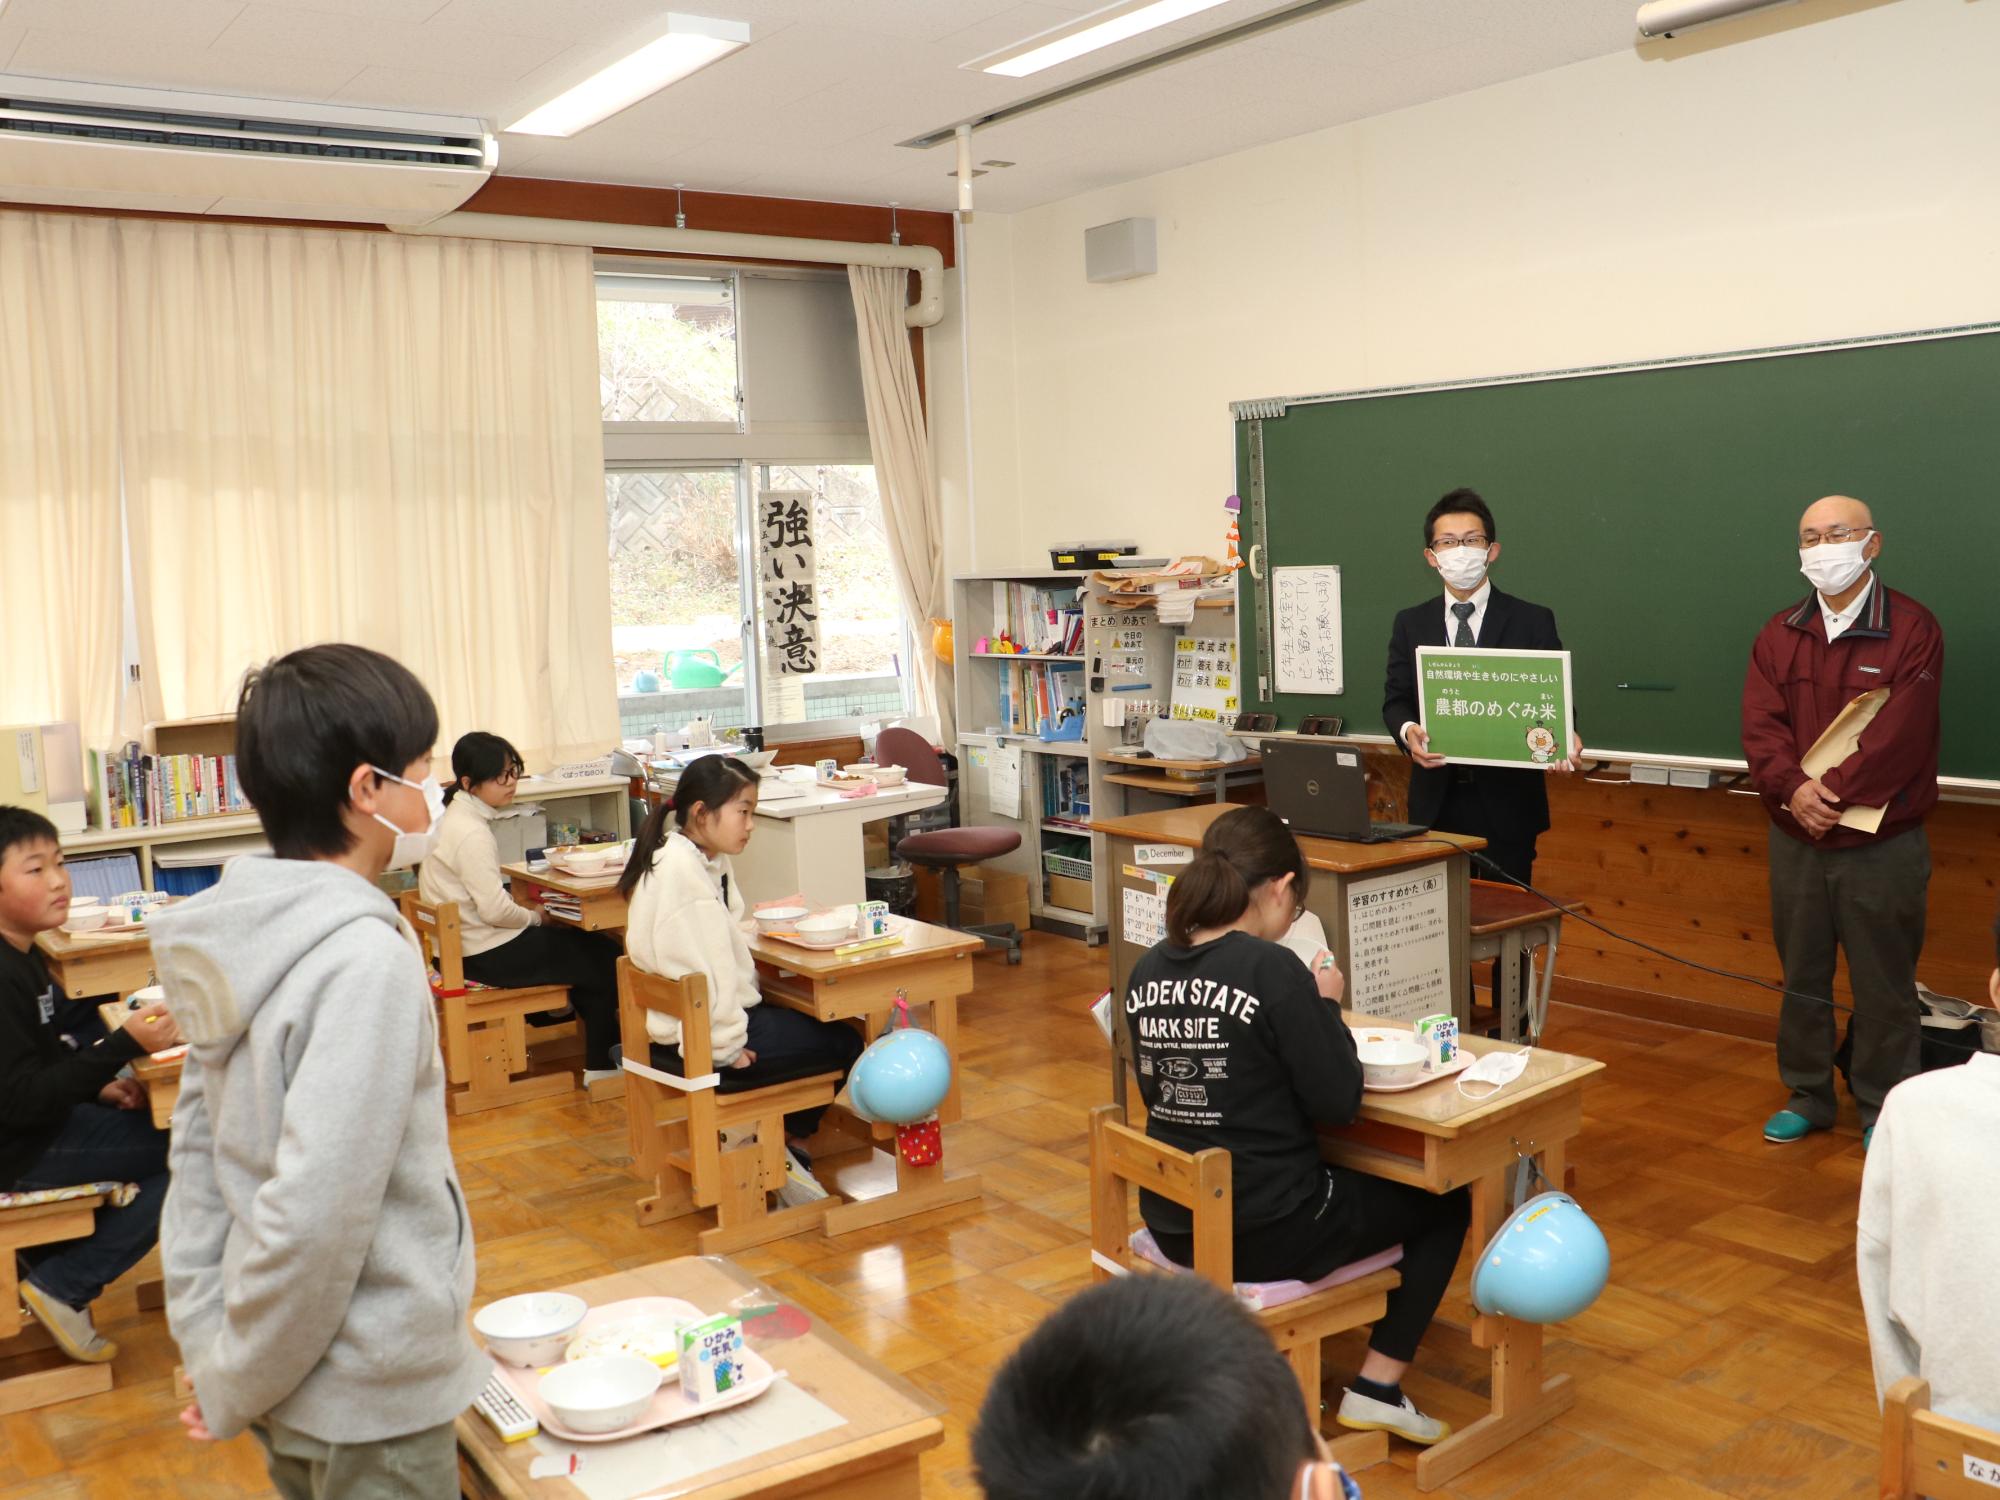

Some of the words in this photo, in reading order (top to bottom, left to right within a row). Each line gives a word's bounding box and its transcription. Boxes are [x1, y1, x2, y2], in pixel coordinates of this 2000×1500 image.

[767, 500, 817, 673] 強い決意
[1091, 615, 1115, 627] まとめ
[1122, 616, 1147, 626] めあて
[1123, 631, 1142, 639] 今日の
[1123, 640, 1142, 648] めあて
[1177, 641, 1194, 650] そして
[1177, 659, 1191, 669] わけ
[1197, 660, 1211, 671] 答え
[1216, 660, 1230, 672] 答え
[1177, 675, 1191, 686] わけ
[1196, 676, 1209, 686] 答え
[1426, 670, 1558, 683] 自然環境や生きものにやさしい
[1435, 698, 1557, 720] 農都のめぐみ米
[1150, 848, 1184, 858] December
[1190, 978, 1260, 1025] STATE
[1140, 1017, 1182, 1039] MARK
[1184, 1017, 1219, 1039] SITE
[1436, 1021, 1454, 1031] ひかみ
[704, 1328, 735, 1348] ひかみ
[711, 1342, 732, 1356] 牛乳
